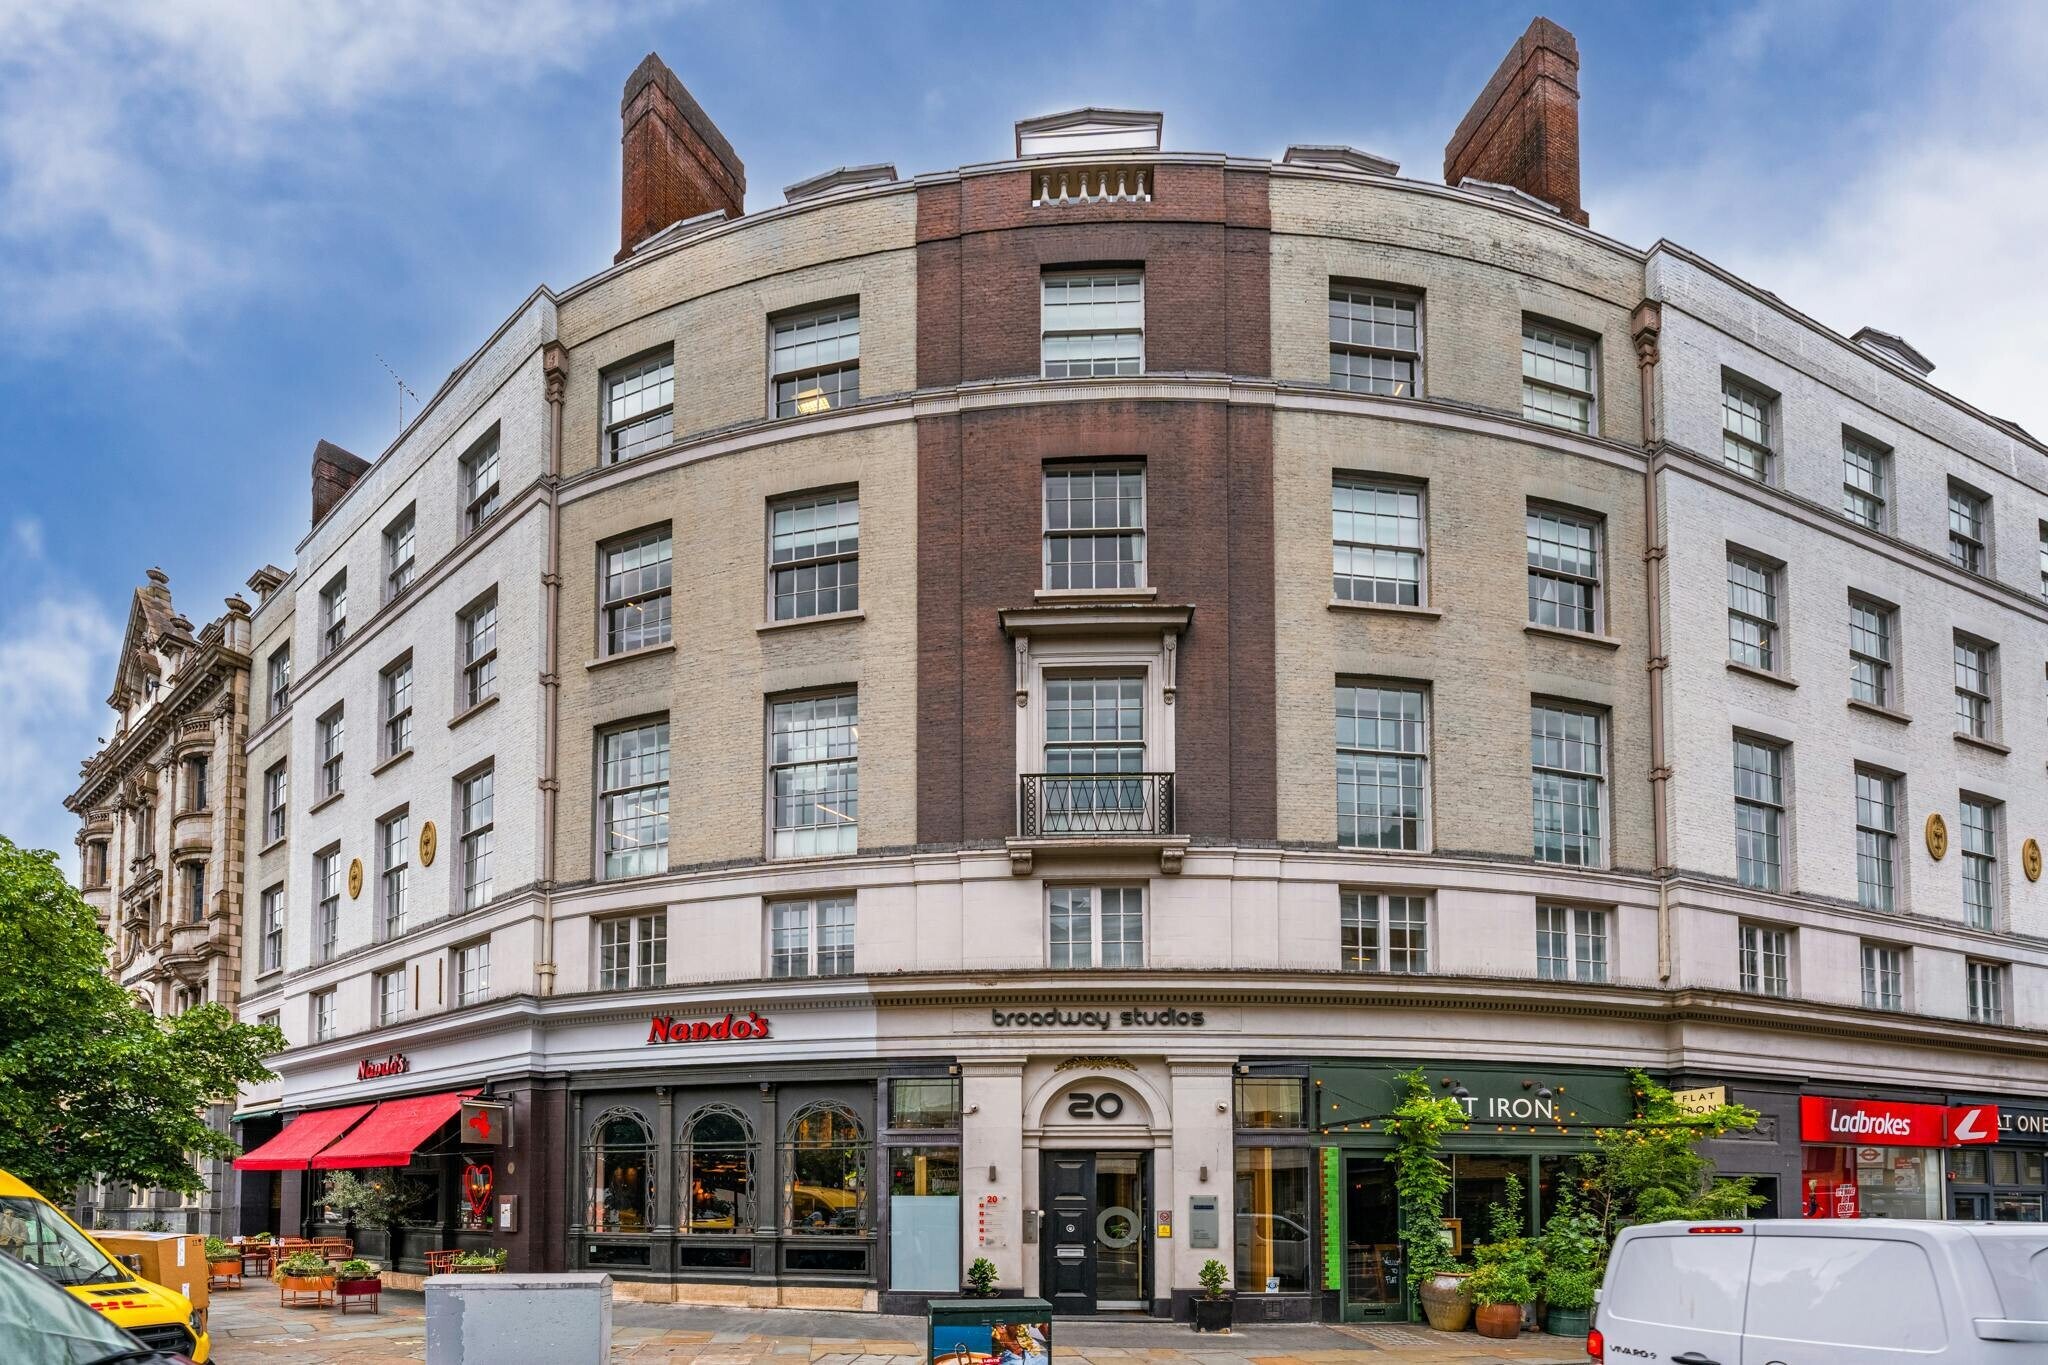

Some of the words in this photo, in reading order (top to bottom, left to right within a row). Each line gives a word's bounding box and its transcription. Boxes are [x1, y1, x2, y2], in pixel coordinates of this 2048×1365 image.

[647, 1011, 770, 1043] Nando's
[992, 1008, 1111, 1030] broadway
[1120, 1008, 1205, 1026] studios
[357, 1053, 406, 1080] Nando's
[1067, 1092, 1124, 1119] 20
[1489, 1097, 1552, 1119] IRON
[1682, 1091, 1716, 1103] FLAT
[1680, 1104, 1717, 1115] IRON
[1830, 1108, 1911, 1136] Ladbrokes
[2017, 1115, 2048, 1133] ONE
[986, 1195, 998, 1203] 20
